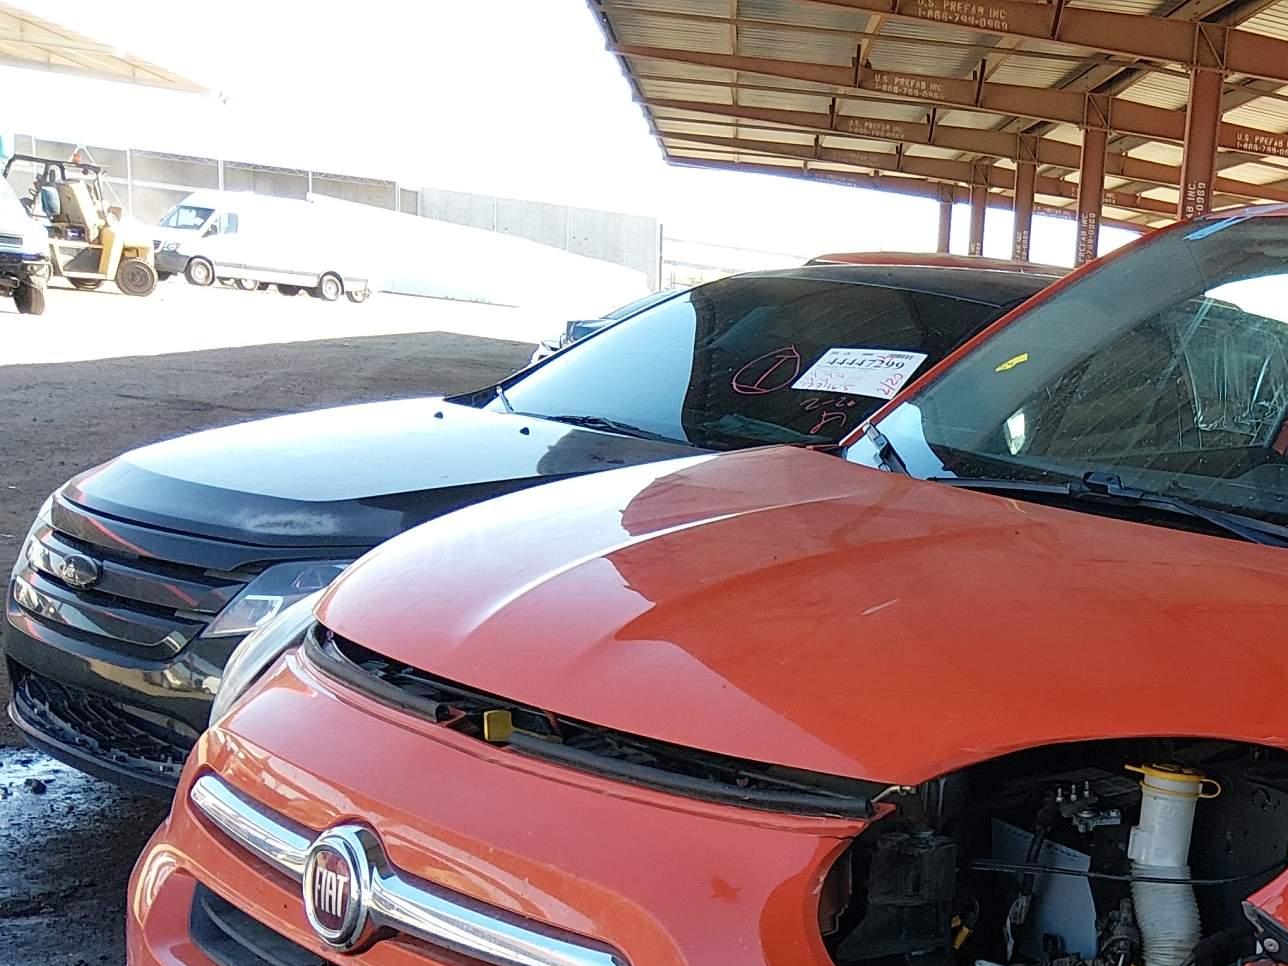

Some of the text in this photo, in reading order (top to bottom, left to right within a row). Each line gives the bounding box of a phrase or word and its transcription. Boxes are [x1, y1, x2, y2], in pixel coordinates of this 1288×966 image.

[943, 1, 984, 16] PREFAB
[826, 357, 906, 371] 44447299
[315, 866, 350, 918] FIAT
